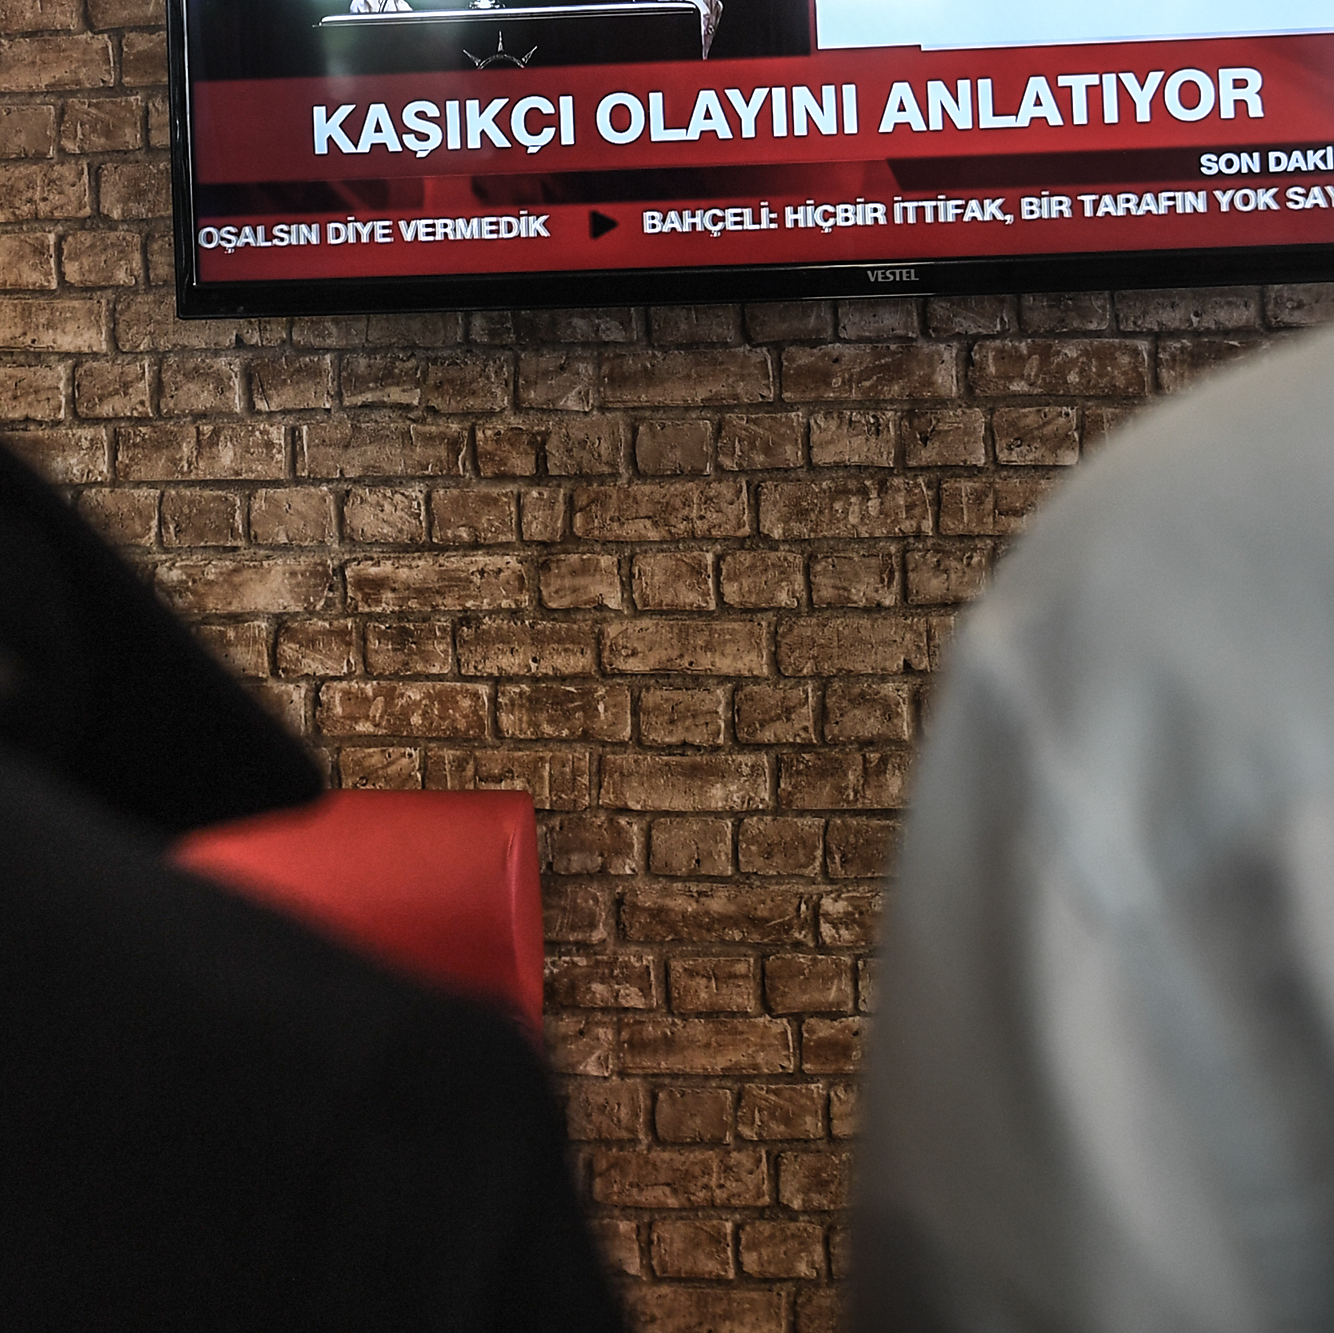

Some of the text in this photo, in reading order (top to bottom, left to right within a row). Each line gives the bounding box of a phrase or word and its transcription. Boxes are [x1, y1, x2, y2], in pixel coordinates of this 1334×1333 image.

[312, 67, 1265, 158] KAŞIKÇI OLAYINI ANLATIYOR
[1199, 152, 1261, 176] SON
[198, 223, 321, 254] OŞALSIN
[327, 216, 394, 246] DİYE
[399, 210, 551, 242] VERMEDİK
[642, 201, 778, 237] BAHÇELİ:
[785, 198, 887, 233] HİÇBİR
[893, 195, 1015, 226] İTTİFAK,
[1020, 191, 1073, 221] BİR
[1077, 190, 1208, 219] TARAFIN
[1213, 186, 1280, 213] YOK
[867, 269, 920, 283] VESTEL
